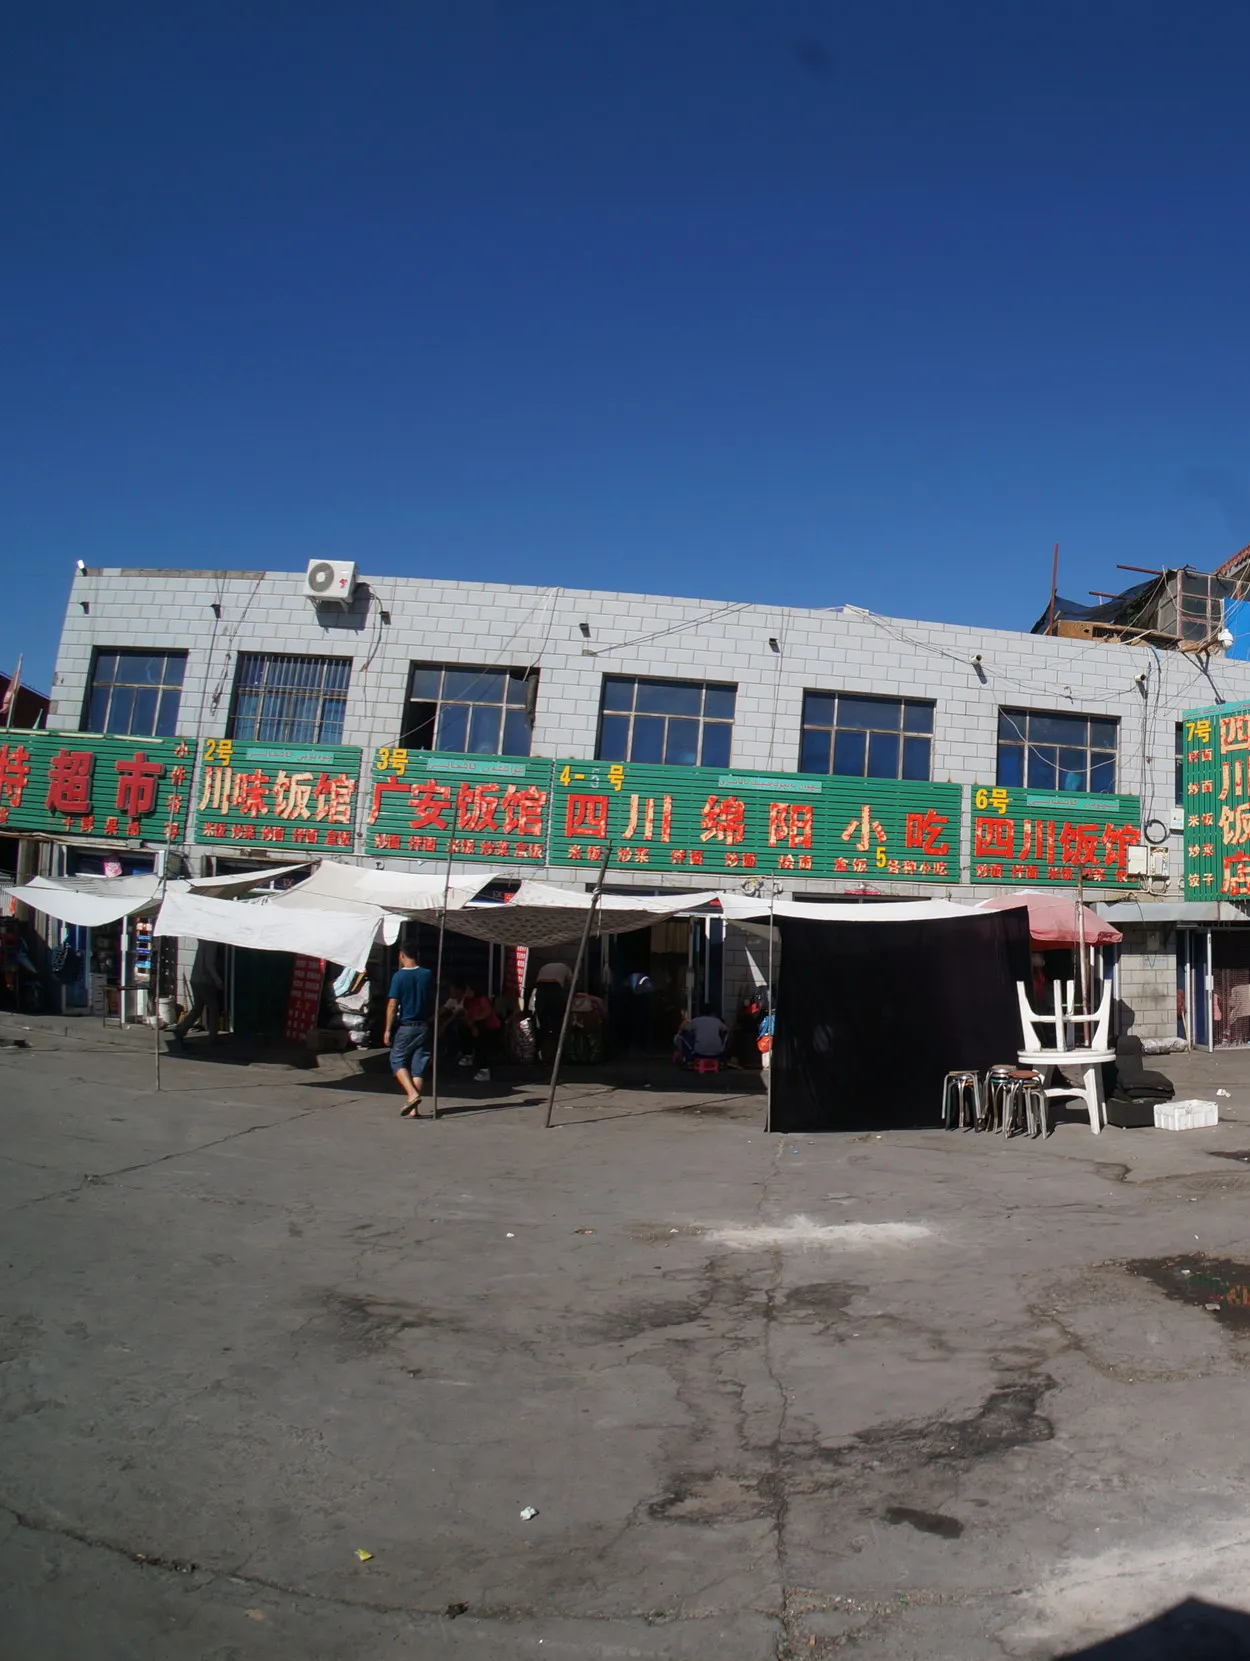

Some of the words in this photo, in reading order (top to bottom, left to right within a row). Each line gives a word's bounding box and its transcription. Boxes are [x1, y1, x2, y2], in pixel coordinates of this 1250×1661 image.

[1186, 720, 1211, 743] 7号
[204, 739, 233, 767] 2号
[377, 748, 408, 776] 3号
[199, 765, 356, 824] 川味饭馆
[1187, 780, 1213, 796] 炒面
[367, 776, 547, 837] 广安饭馆
[975, 788, 1009, 815] 6号
[565, 793, 949, 856] 四川绵阳小吃
[1187, 813, 1214, 828] 米饭
[975, 817, 1140, 867] 四川饭馆
[1187, 843, 1215, 858] 炒菜
[876, 847, 886, 868] 5
[887, 860, 948, 876] 各种小吃
[1187, 873, 1216, 888] 饺子
